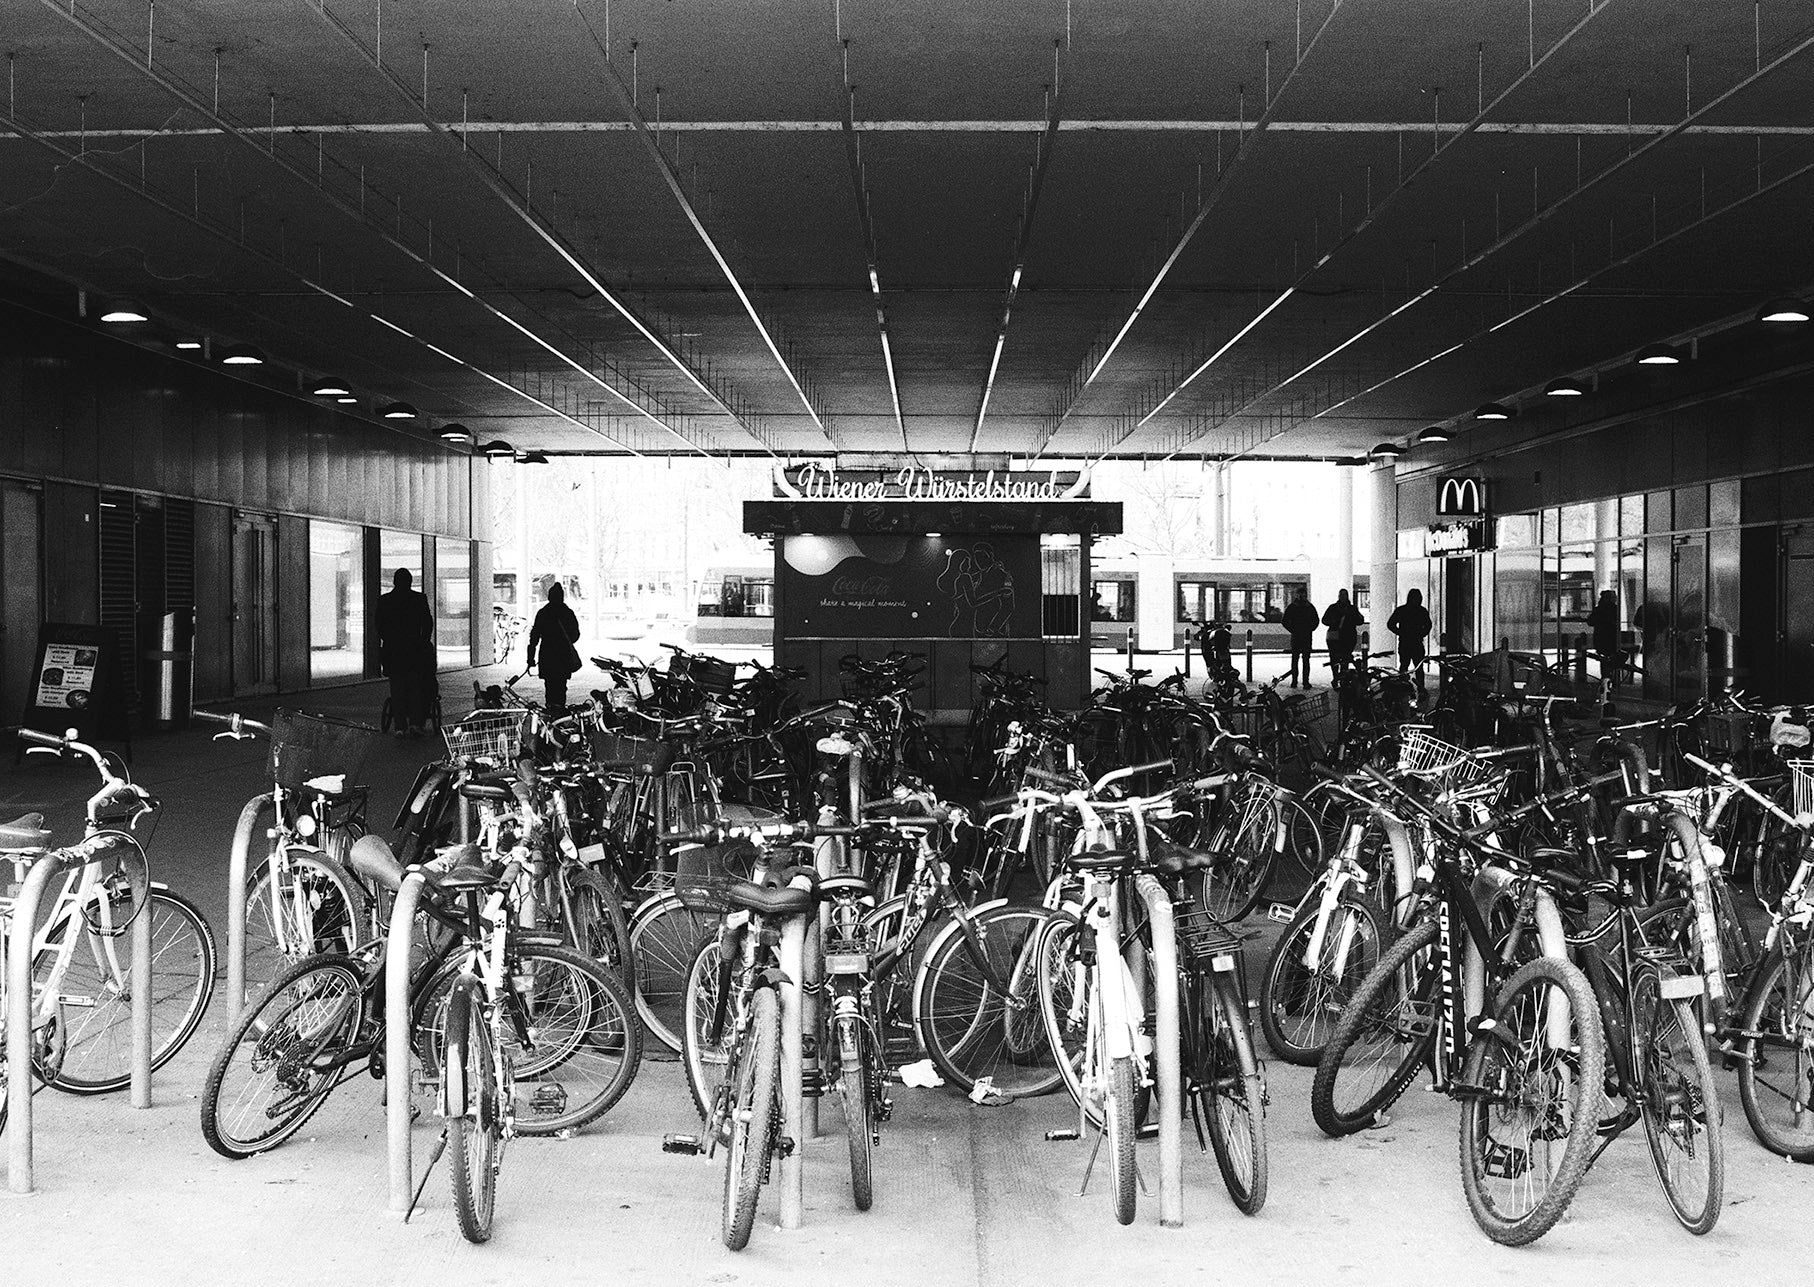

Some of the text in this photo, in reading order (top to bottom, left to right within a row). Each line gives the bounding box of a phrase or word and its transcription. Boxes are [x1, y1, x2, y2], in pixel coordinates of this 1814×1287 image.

[798, 466, 1059, 499] Wiener Würstelstand
[1440, 478, 1479, 513] M
[820, 598, 838, 607] share
[848, 598, 875, 610] magical
